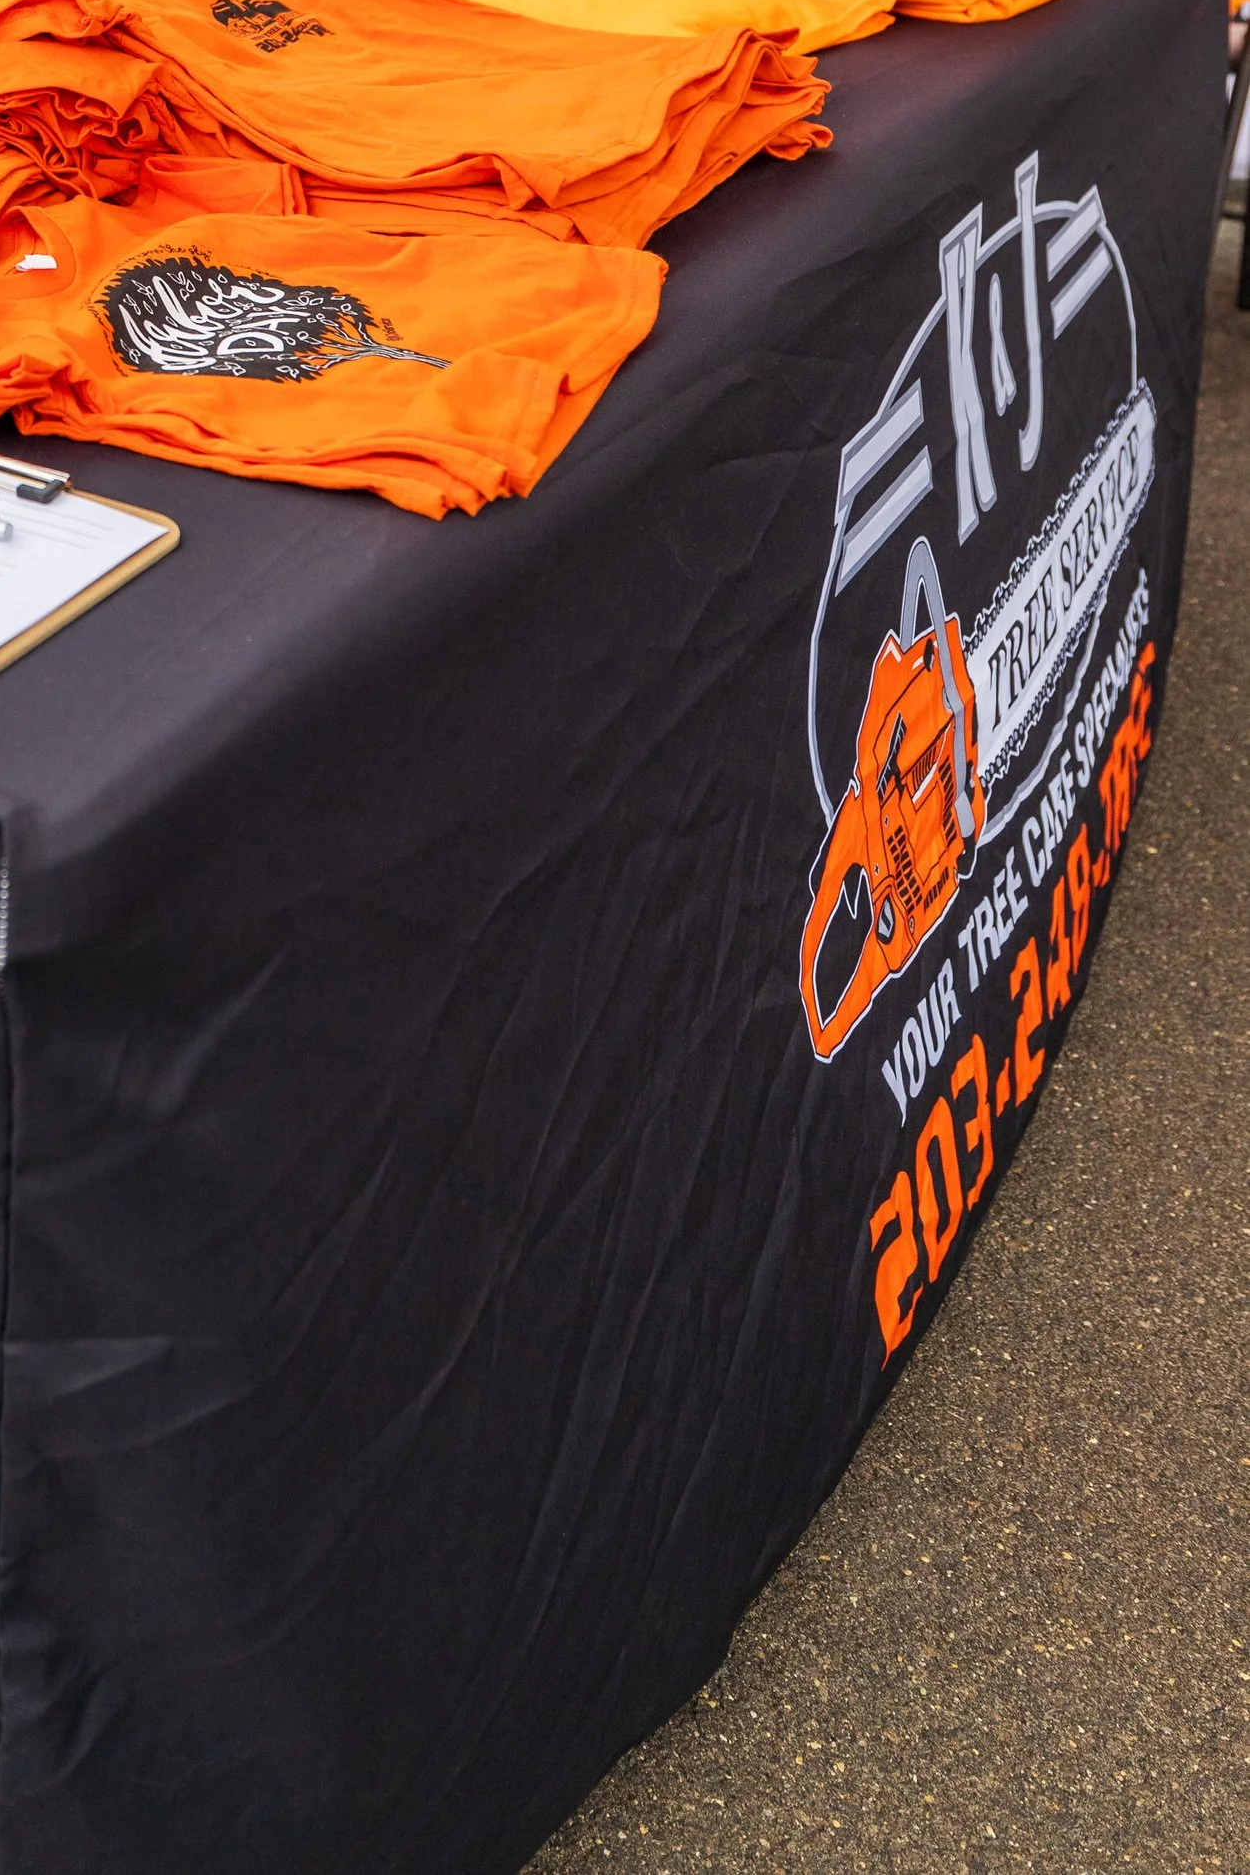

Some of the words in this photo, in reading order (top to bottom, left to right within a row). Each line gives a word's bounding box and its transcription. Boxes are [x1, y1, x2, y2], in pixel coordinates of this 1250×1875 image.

[216, 303, 312, 356] DAY
[940, 149, 1044, 547] K&J
[987, 567, 1059, 731] TREE
[1058, 424, 1141, 614] SERVICE
[881, 956, 960, 1126] YOUR
[958, 853, 1030, 985] TREE
[1021, 749, 1078, 881] CARE
